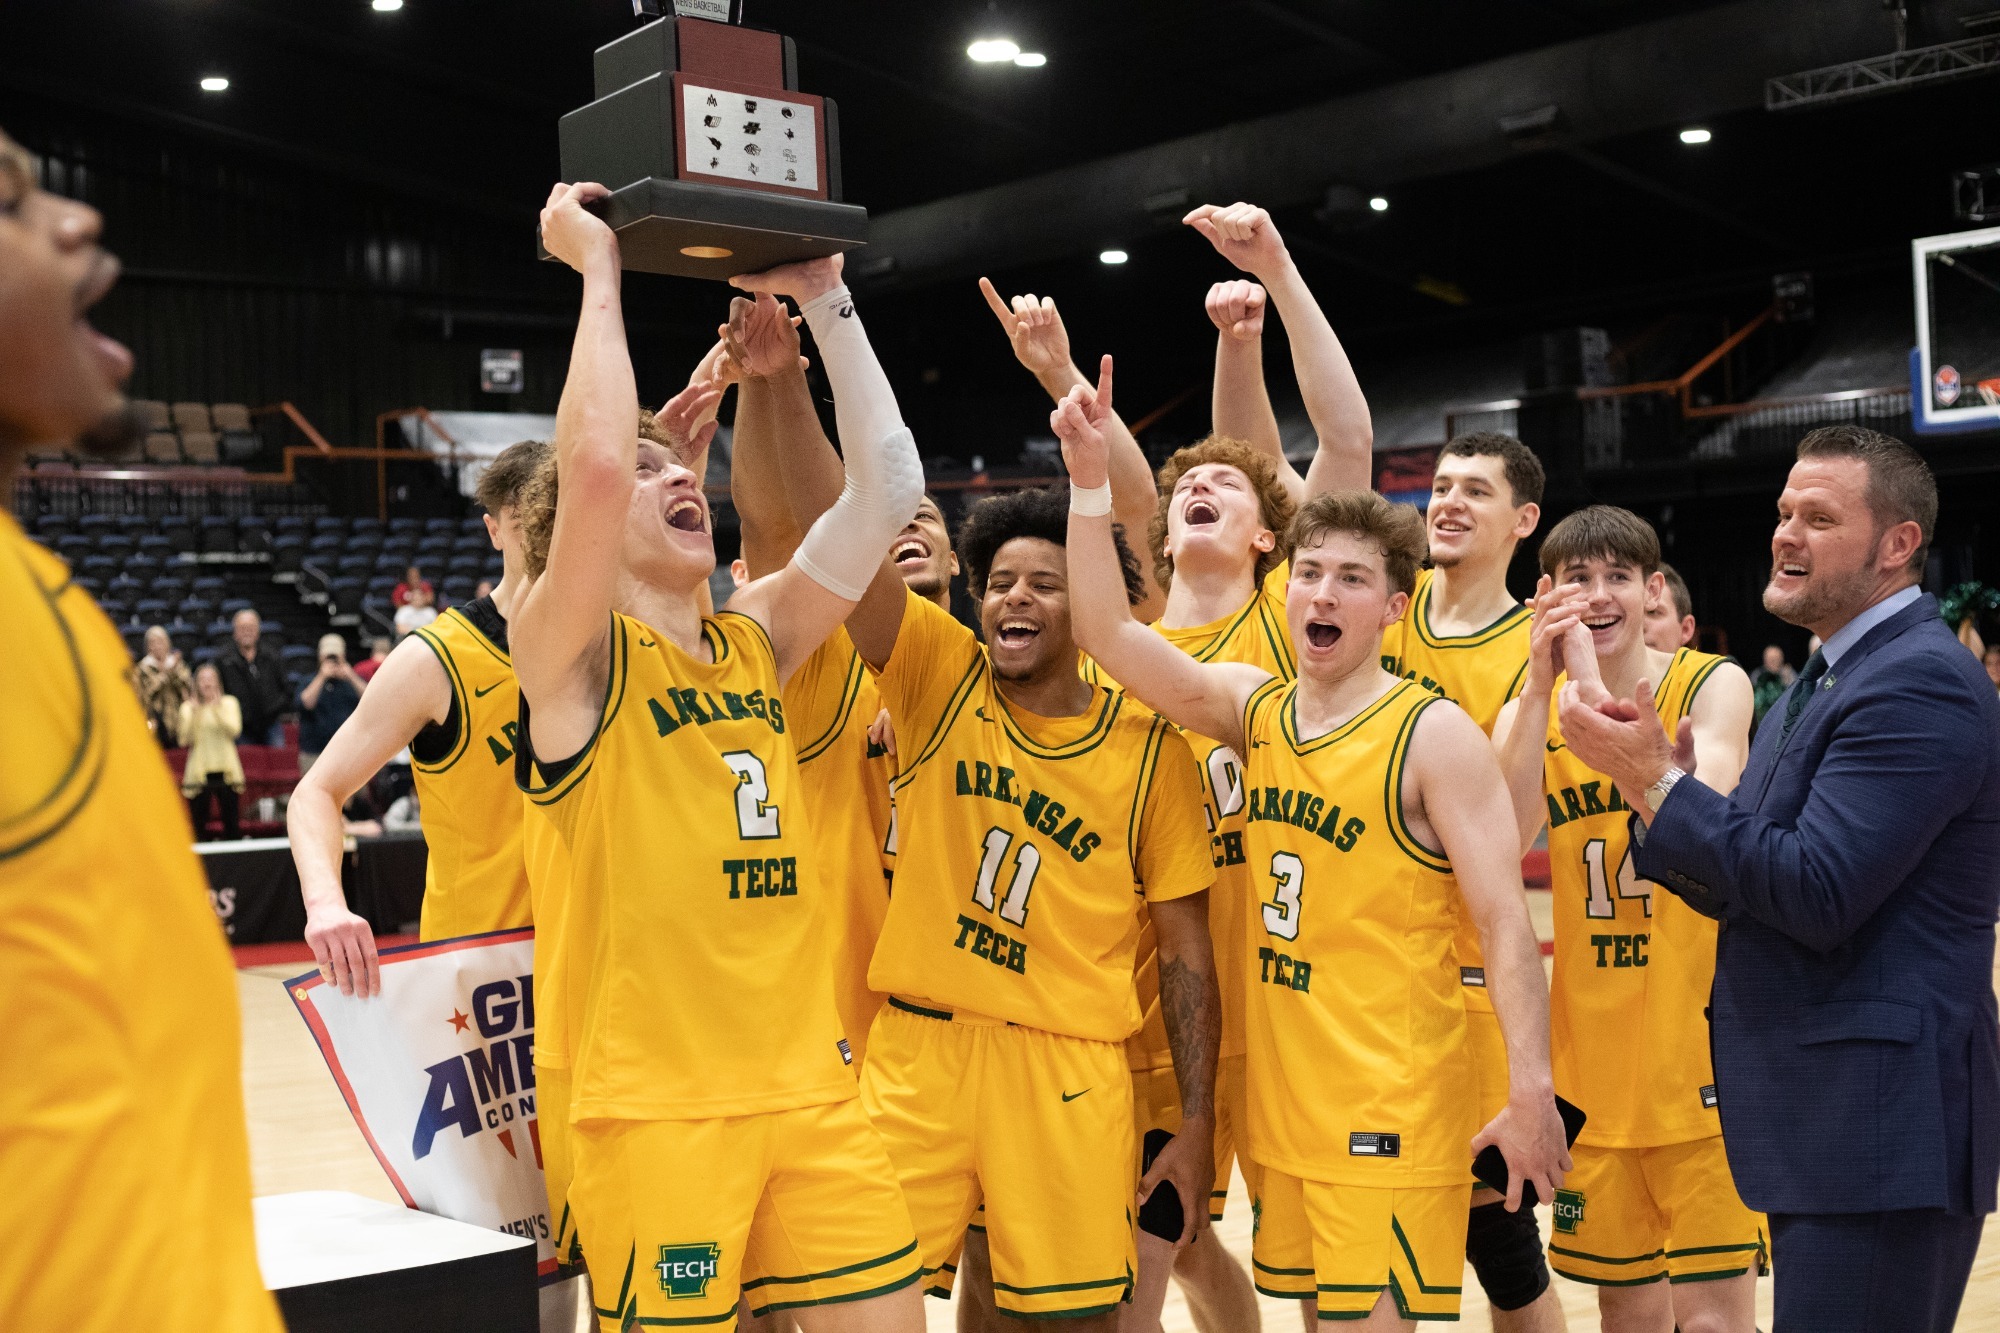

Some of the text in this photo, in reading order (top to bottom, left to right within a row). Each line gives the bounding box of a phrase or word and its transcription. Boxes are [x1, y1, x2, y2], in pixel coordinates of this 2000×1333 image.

[694, 0, 728, 14] BASKETBALL
[721, 749, 781, 840] 2
[1211, 831, 1246, 868] CH
[723, 857, 798, 899] TECH
[971, 826, 1041, 929] 11
[1261, 850, 1304, 942] 3
[953, 913, 1027, 975] TECH
[1591, 933, 1650, 968] TEC
[1554, 1202, 1582, 1219] TECH
[658, 1260, 714, 1279] TECH
